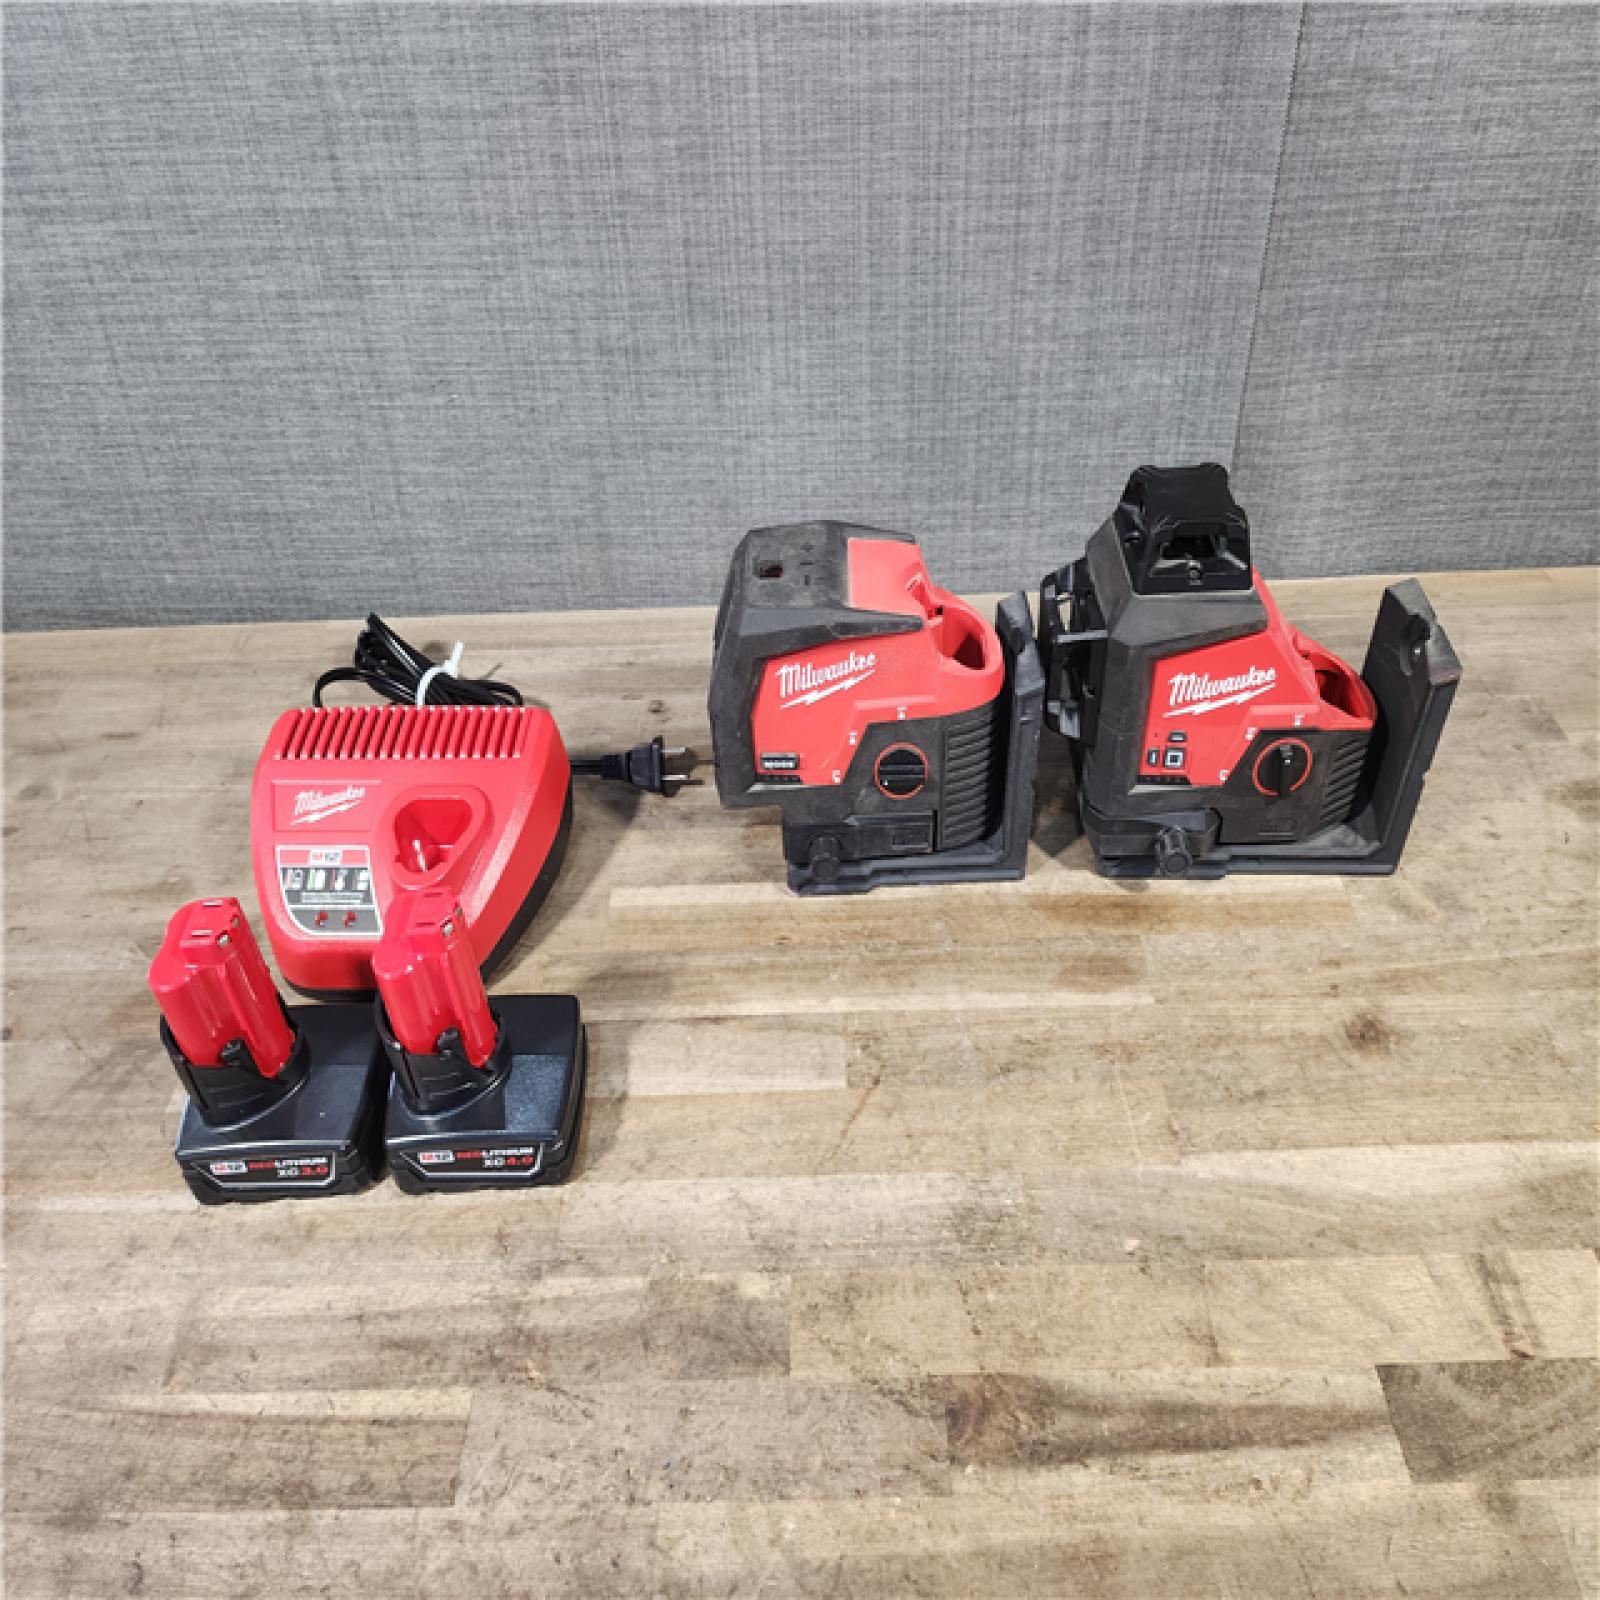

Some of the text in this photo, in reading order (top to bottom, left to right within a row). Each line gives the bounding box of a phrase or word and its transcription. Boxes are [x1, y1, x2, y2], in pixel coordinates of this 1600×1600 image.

[776, 651, 876, 698] Milwaukee
[1168, 665, 1276, 706] Milwaukee
[294, 785, 366, 815] Milwaukee
